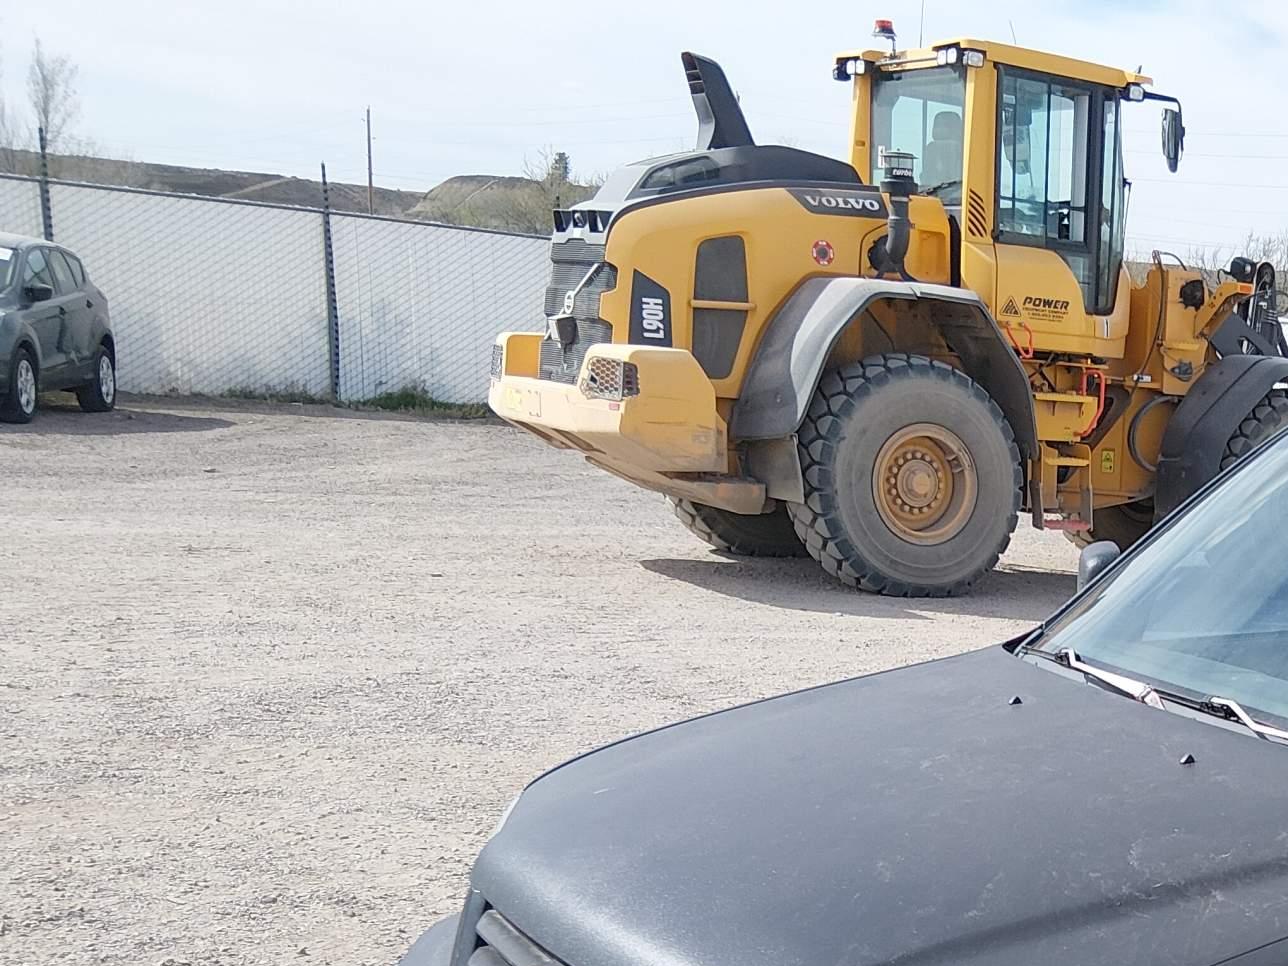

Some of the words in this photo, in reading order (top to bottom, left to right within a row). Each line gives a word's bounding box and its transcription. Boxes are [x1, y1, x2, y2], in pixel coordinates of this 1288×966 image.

[805, 195, 880, 211] VOLVO
[1022, 296, 1070, 311] POWER
[641, 297, 665, 339] L90H
